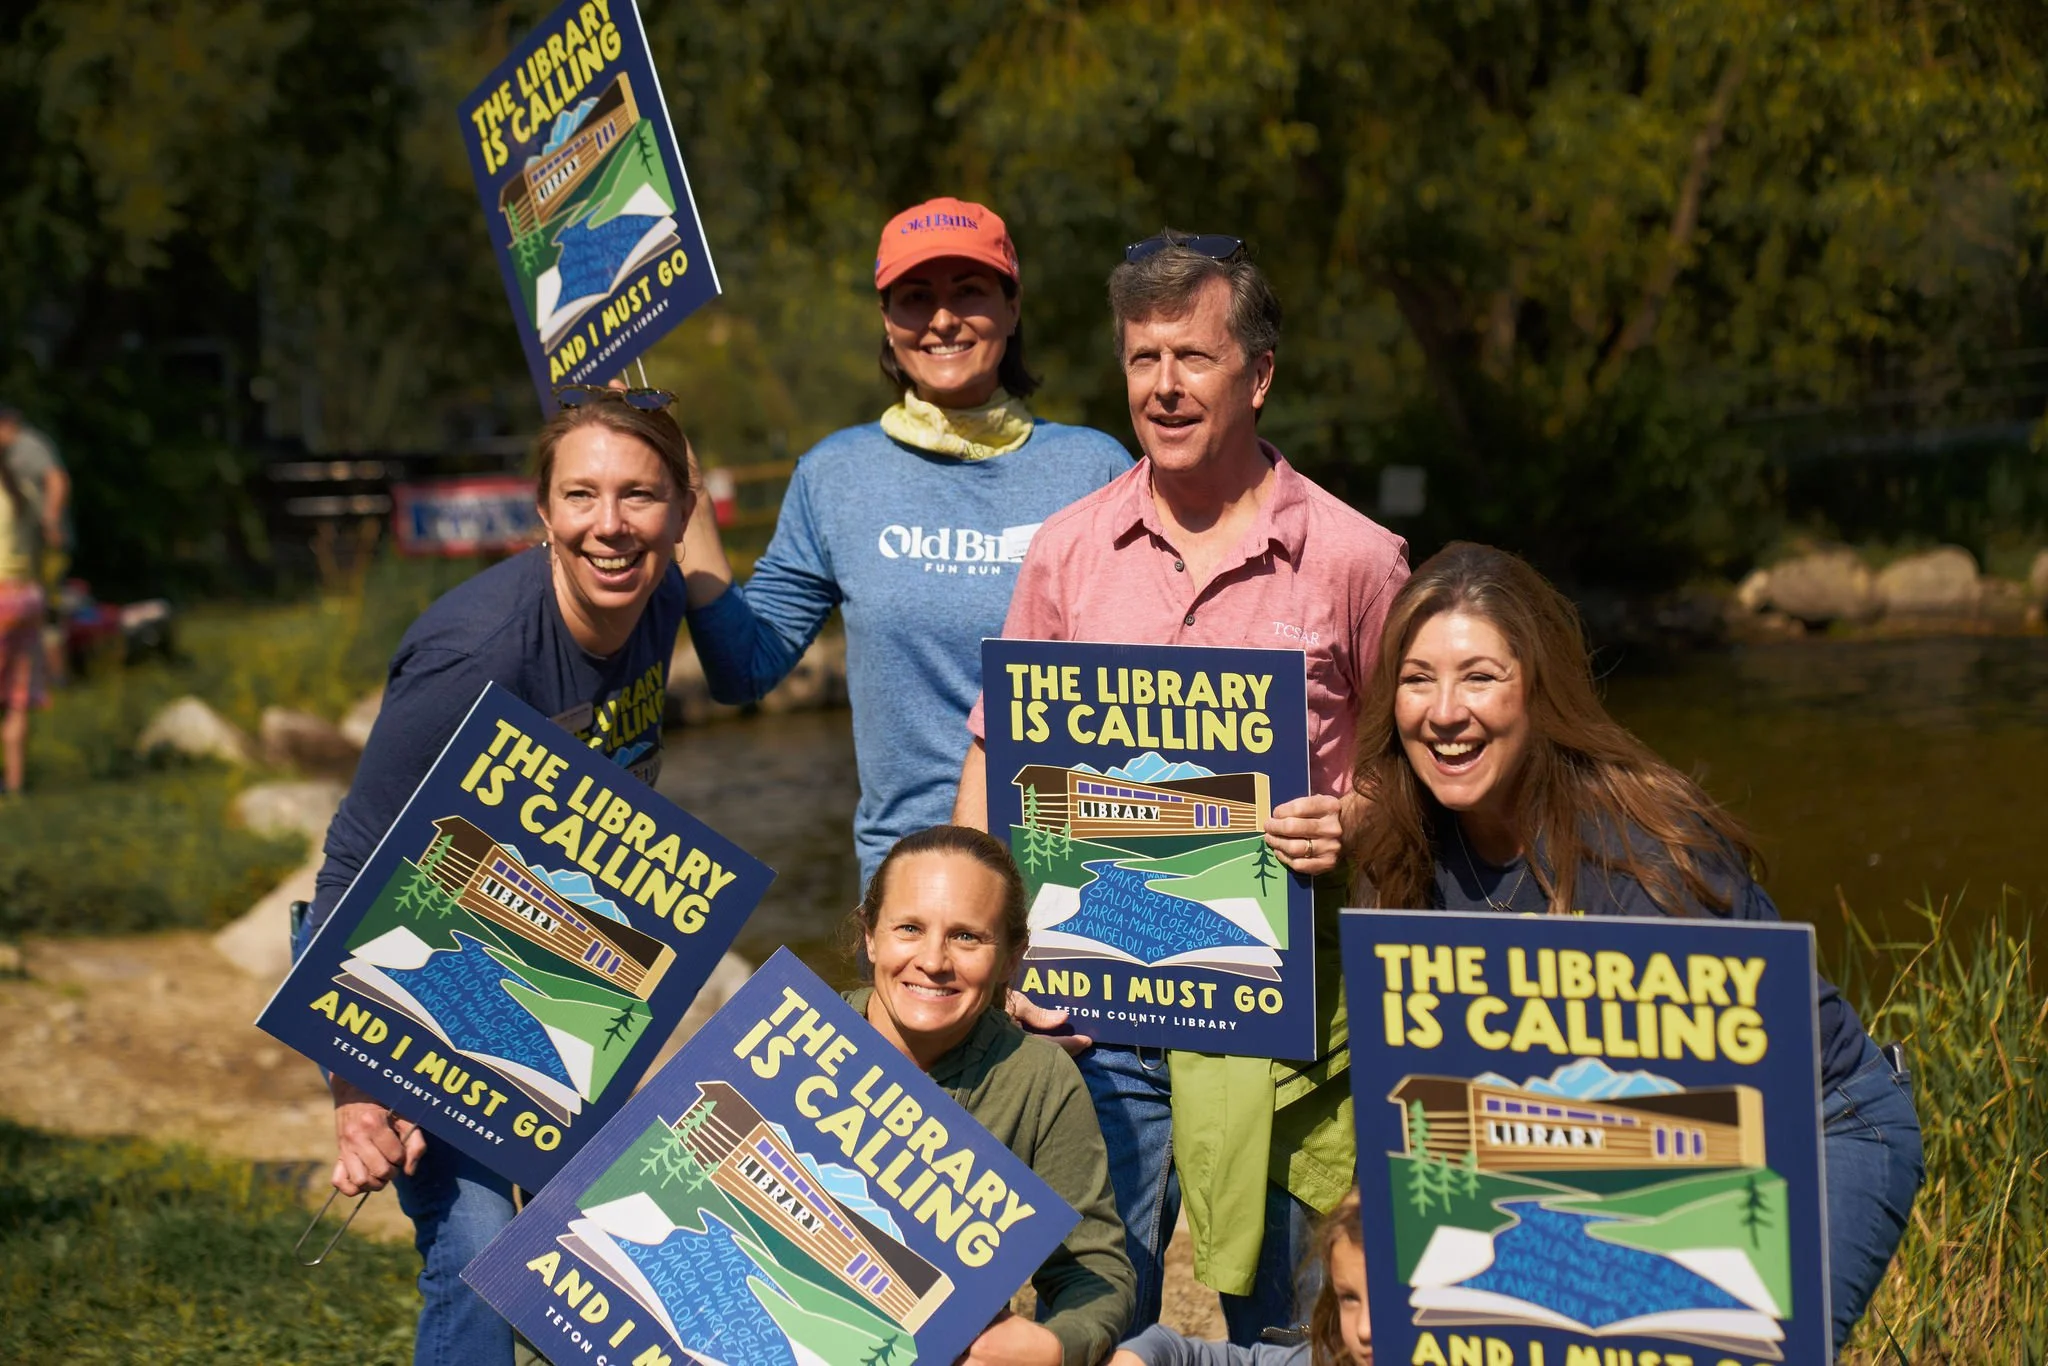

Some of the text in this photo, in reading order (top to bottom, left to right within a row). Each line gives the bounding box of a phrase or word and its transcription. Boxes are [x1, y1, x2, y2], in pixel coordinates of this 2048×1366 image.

[471, 0, 610, 139] THE LIBRARY
[482, 21, 622, 176] IS CALLING
[536, 155, 581, 205] LIBRARY
[550, 335, 587, 384] AND
[588, 322, 599, 347] I
[602, 275, 652, 337] MUST
[657, 249, 688, 287] GO
[598, 329, 632, 361] COUNTY
[632, 298, 670, 333] LIBRARY
[878, 524, 950, 560] Old
[924, 562, 1000, 575] FUN RUN
[1273, 621, 1320, 646] TCSAR
[1005, 663, 1273, 710] THE LIBRARY
[1010, 700, 1274, 754] IS CALLING
[487, 718, 737, 900] THE LIBRARY
[1080, 801, 1158, 819] LIBRARY
[460, 752, 711, 935] IS CALLING
[481, 875, 559, 933] LIBRARY
[1087, 881, 1205, 941] BALDWIN COELHO
[1098, 864, 1251, 945] SHAKESPEARE ALLENDE
[1058, 919, 1167, 959] BOX ANGELOU POE
[440, 953, 496, 1016] BALDWIN
[1021, 967, 1284, 1015] AND I MUST GO
[1374, 943, 1767, 1007] THE LIBRARY
[414, 982, 465, 1035] ANGELOU
[459, 1034, 484, 1050] POE
[1107, 1010, 1166, 1025] COUNTY
[1173, 1017, 1238, 1031] LIBRARY
[1382, 991, 1769, 1065] IS CALLING
[309, 990, 562, 1151] AND I MUST GO
[333, 1037, 504, 1146] TETON COUNTY LIBRARY
[769, 986, 1037, 1233] THE LIBRARY
[1488, 1120, 1604, 1147] LIBRARY
[732, 1018, 1000, 1267] IS CALLING
[738, 1155, 823, 1235] LIBRARY
[526, 1251, 636, 1349] AND I
[619, 1239, 653, 1265] BOX
[645, 1262, 698, 1330] ANGELOU
[682, 1236, 736, 1315] BALDWIN
[709, 1225, 782, 1343] SHAKESPEARE
[544, 1305, 593, 1354] TETON
[1411, 1331, 1514, 1366] AND
[1528, 1340, 1545, 1366] I
